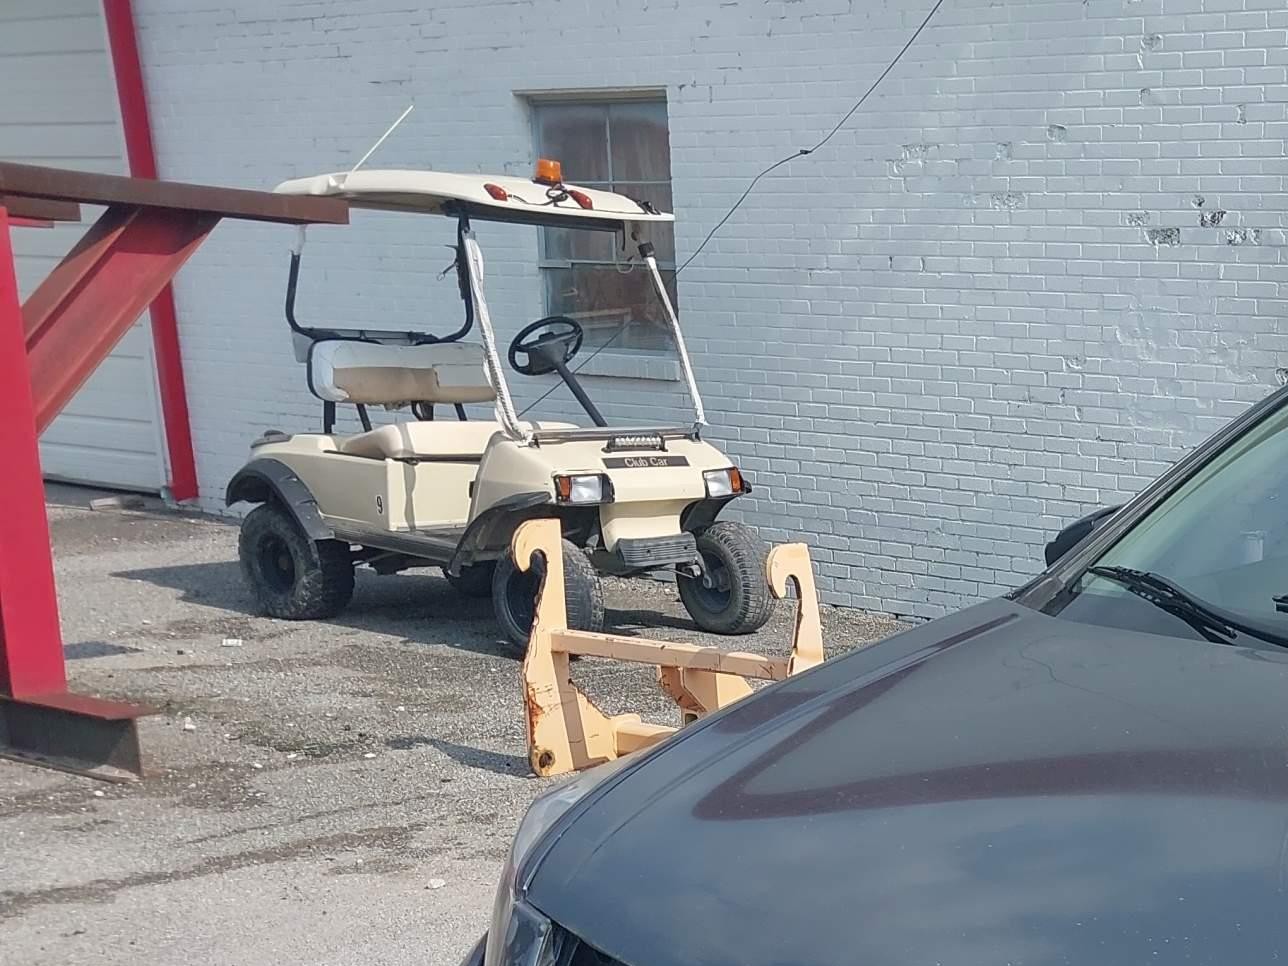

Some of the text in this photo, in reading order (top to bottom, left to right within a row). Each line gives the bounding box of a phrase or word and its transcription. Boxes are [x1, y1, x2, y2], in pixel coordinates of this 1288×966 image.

[624, 457, 669, 468] Club Car
[376, 495, 384, 515] 9
